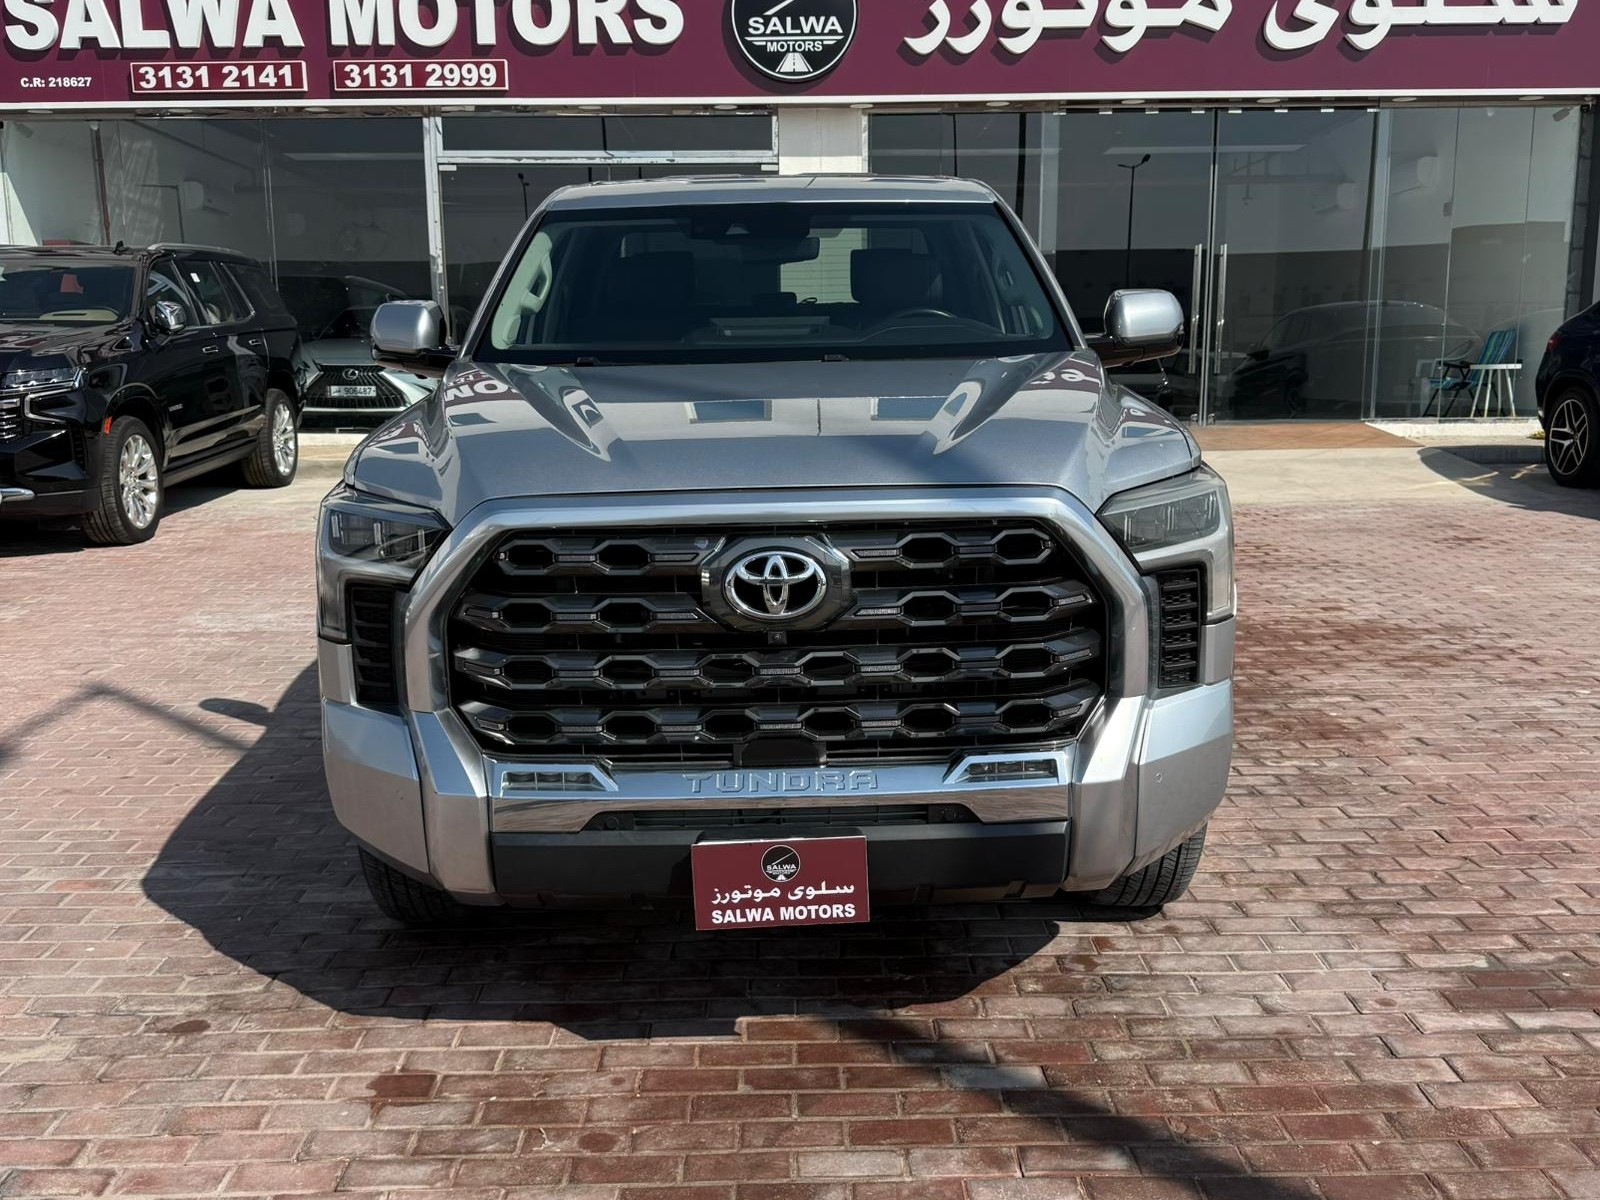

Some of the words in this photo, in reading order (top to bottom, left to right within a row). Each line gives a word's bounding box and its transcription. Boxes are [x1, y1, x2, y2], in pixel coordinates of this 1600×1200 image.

[5, 0, 305, 50] SALWA
[329, 0, 684, 47] MOTORS
[748, 16, 843, 34] SALWA
[766, 41, 823, 52] MOTORS
[20, 78, 46, 88] C.R:
[48, 77, 92, 87] 218627
[138, 66, 210, 88] 3131
[221, 65, 293, 88] 2141
[344, 64, 413, 87] 3131
[425, 63, 497, 87] 2999
[683, 770, 879, 793] TUNDRA
[766, 863, 797, 871] SALWA
[712, 885, 781, 905] موتورز
[788, 881, 855, 900] سلوى
[711, 908, 775, 924] SALWA
[780, 903, 856, 921] MOTORS
